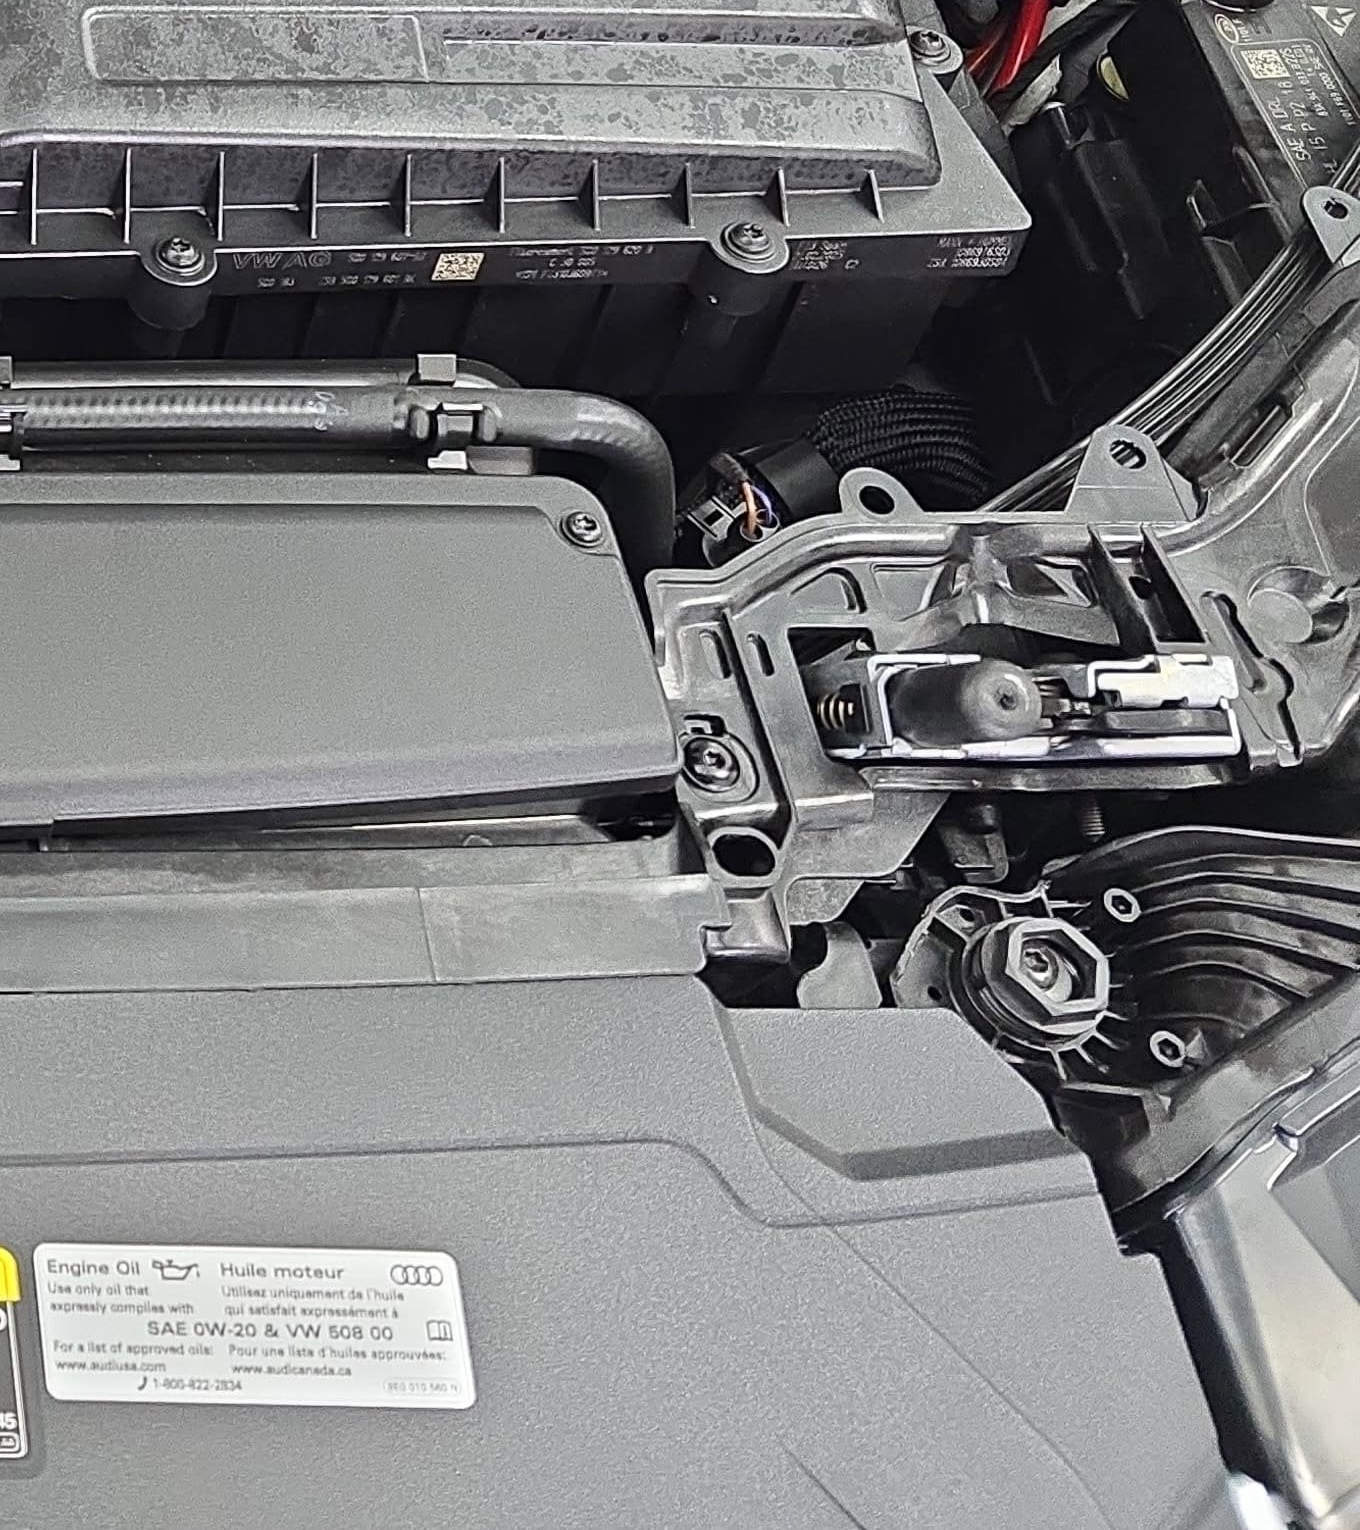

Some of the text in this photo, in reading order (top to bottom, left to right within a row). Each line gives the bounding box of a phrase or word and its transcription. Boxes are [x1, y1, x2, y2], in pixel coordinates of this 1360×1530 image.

[1279, 122, 1297, 133] A
[1300, 123, 1317, 132] P
[1285, 137, 1312, 161] SAE
[1308, 136, 1329, 151] 15
[47, 1259, 140, 1278] Engine Oil
[220, 1262, 345, 1280] Huile moteur
[47, 1282, 149, 1297] Use only oil that
[220, 1286, 405, 1302] Utilisez uniquement de l'huile
[49, 1301, 194, 1316] expressly complies with
[223, 1305, 399, 1319] qui satisfait expressément à
[147, 1321, 394, 1341] SAE 0W-20 & VW 508 00
[53, 1340, 214, 1356] For a list of approved oils:
[228, 1344, 257, 1357] Pour
[261, 1347, 284, 1358] une
[288, 1345, 314, 1358] liste
[56, 1360, 167, 1373] www.audiusa.com
[231, 1364, 352, 1377] www.audicanada.ca
